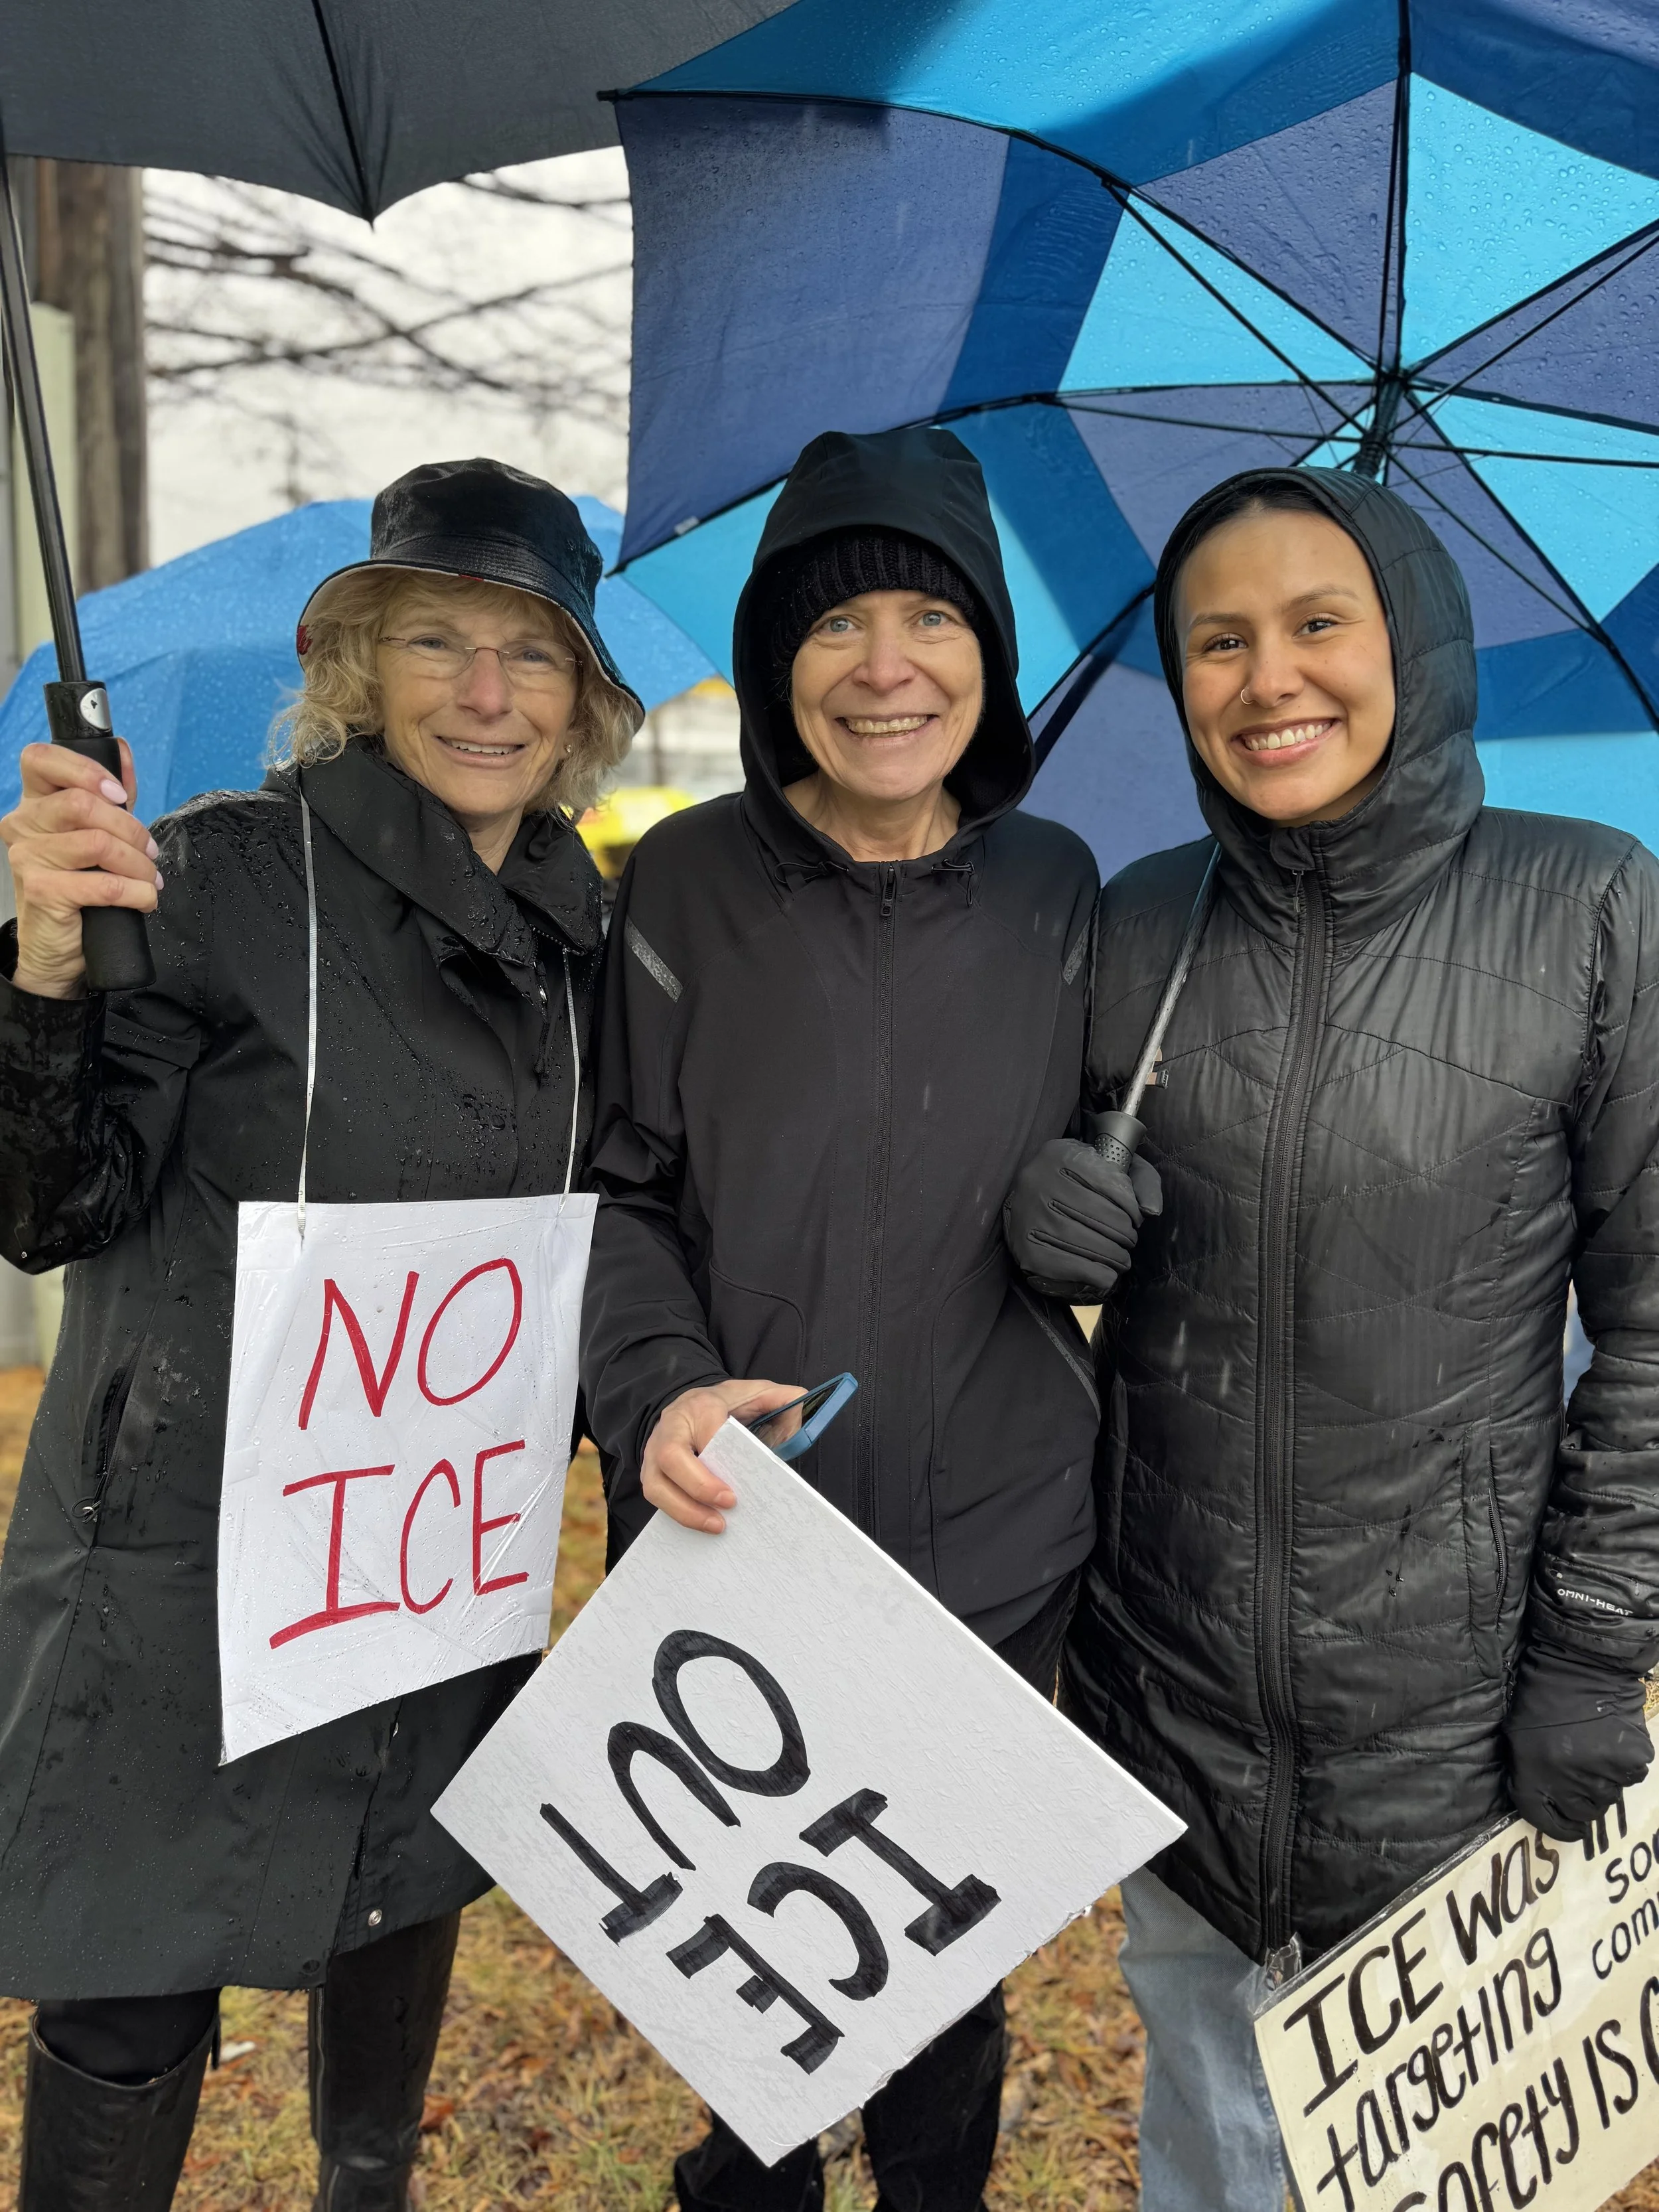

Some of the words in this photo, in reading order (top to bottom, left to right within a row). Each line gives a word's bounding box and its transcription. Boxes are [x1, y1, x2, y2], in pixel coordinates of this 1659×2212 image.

[298, 1258, 523, 1430] NO
[269, 1439, 529, 1650] ICE
[1557, 1588, 1634, 1616] OMNI-HEAT
[540, 1629, 811, 1947] OUT
[1605, 1828, 1659, 1904] so
[666, 1788, 1001, 2075] ICE
[1283, 1908, 1443, 2117] ICE
[1592, 1891, 1659, 1980] com
